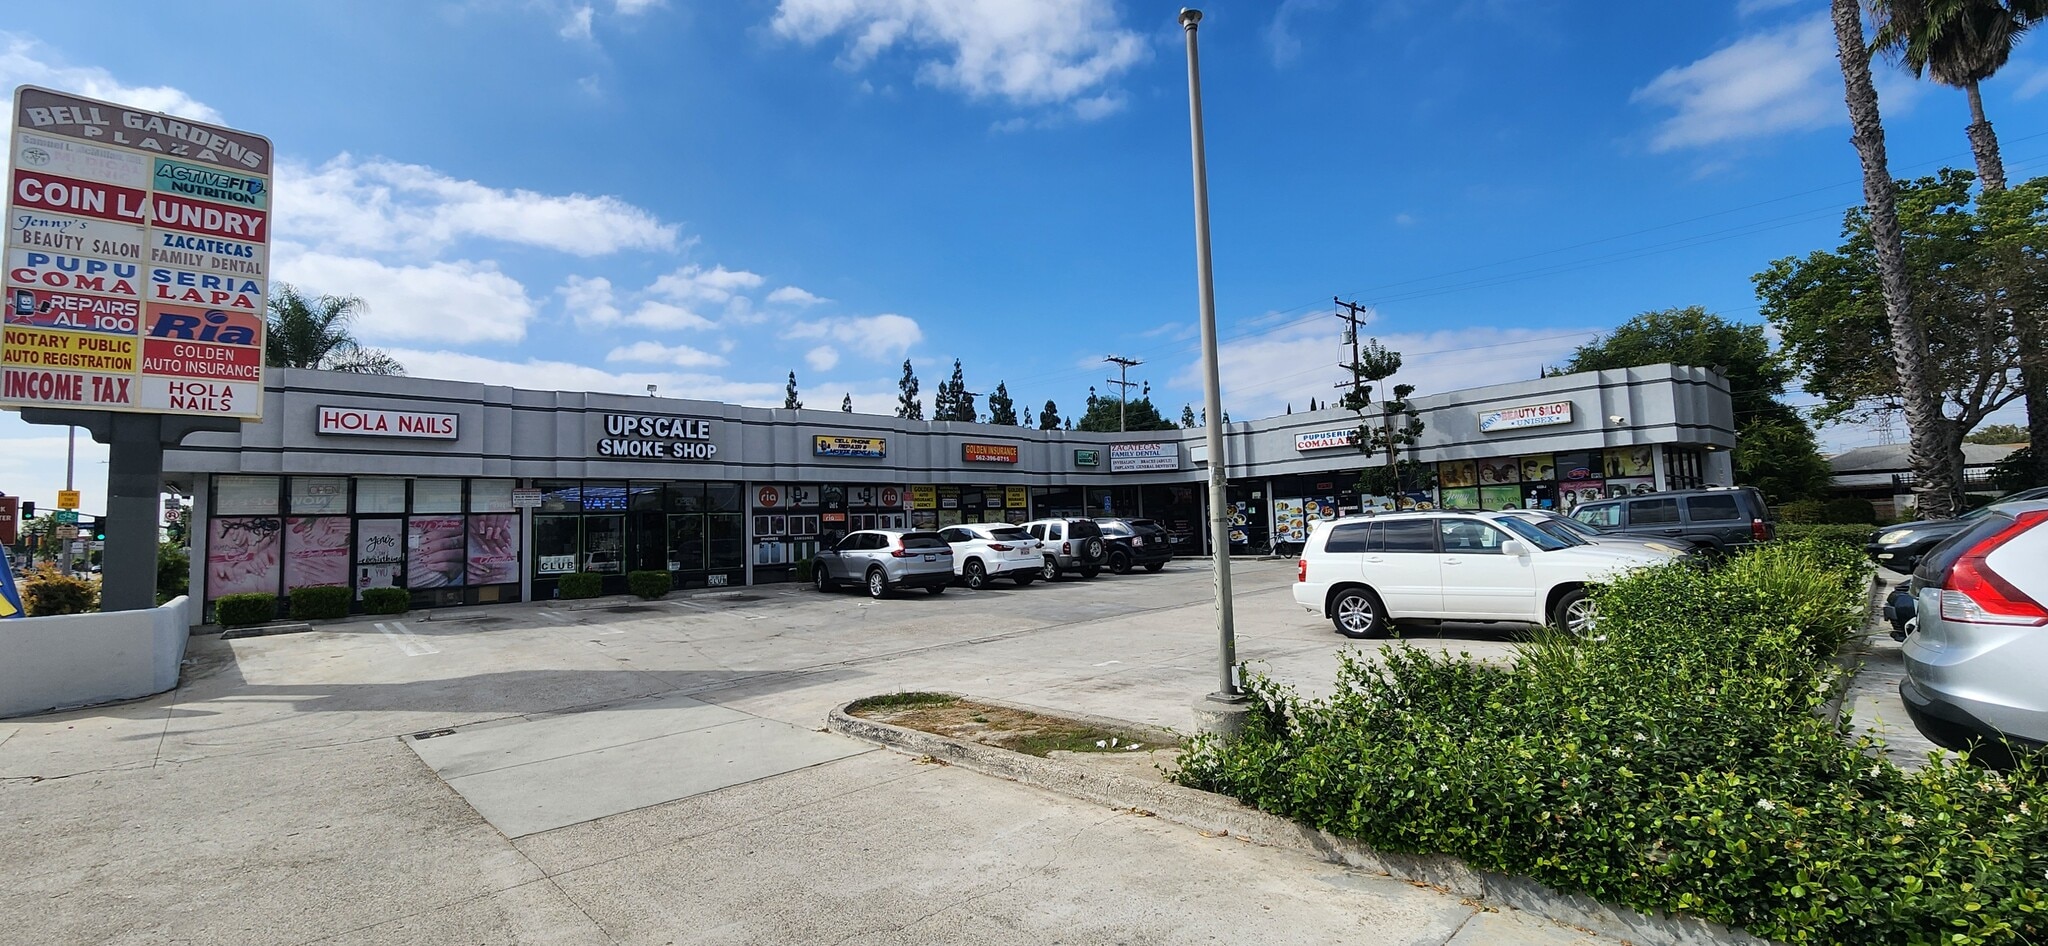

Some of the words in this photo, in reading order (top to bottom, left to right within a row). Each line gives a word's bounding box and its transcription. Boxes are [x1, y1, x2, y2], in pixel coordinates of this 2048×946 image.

[22, 134, 65, 151] Samuel
[65, 142, 74, 153] L.
[25, 105, 110, 127] BELL
[122, 111, 263, 169] GARDENS
[83, 125, 220, 162] PLAZA
[156, 163, 255, 194] ACTIVEFIT
[171, 180, 256, 205] NUTRITION
[18, 177, 105, 213] COIN
[117, 194, 264, 237] LAUNDRY
[12, 214, 88, 234] Jenny's
[22, 229, 85, 251] BEAUTY
[92, 239, 141, 259] SALON
[163, 233, 254, 259] ZACATECAS
[151, 248, 204, 268] FAMILY
[211, 256, 263, 276] DENTAL
[26, 252, 137, 279] PUPU
[152, 268, 261, 296] SERIA
[10, 267, 137, 296] COMA
[156, 284, 256, 309] LAPA
[50, 293, 138, 317] REPAIRS
[53, 311, 87, 329] AL
[93, 314, 135, 333] 100
[151, 309, 255, 347] Ria
[5, 331, 70, 350] NOTARY
[78, 337, 132, 354] PUBLIC
[173, 344, 235, 362] GOLDEN
[3, 349, 40, 364] AUTO
[42, 352, 132, 370] REGISTRATION
[142, 356, 182, 374] AUTO
[184, 360, 260, 379] INSURANCE
[3, 370, 83, 401] INCOME
[91, 376, 131, 404] TAX
[169, 381, 234, 399] HOLA
[169, 397, 232, 412] NAILS
[1501, 407, 1536, 421] BEAUTY
[1538, 402, 1569, 416] SALON
[323, 411, 388, 432] HOLA
[398, 416, 453, 434] NAILS
[606, 415, 710, 440] UPSCALE
[1516, 415, 1554, 426] UNISEX
[600, 439, 664, 457] SMOKE
[672, 443, 718, 459] SHOP
[965, 445, 988, 454] GOLDEN
[988, 446, 1017, 456] INSURANCE
[1111, 443, 1161, 451] ZACATECAS
[761, 490, 777, 502] ria
[884, 491, 896, 501] ria
[541, 562, 574, 571] CLUB
